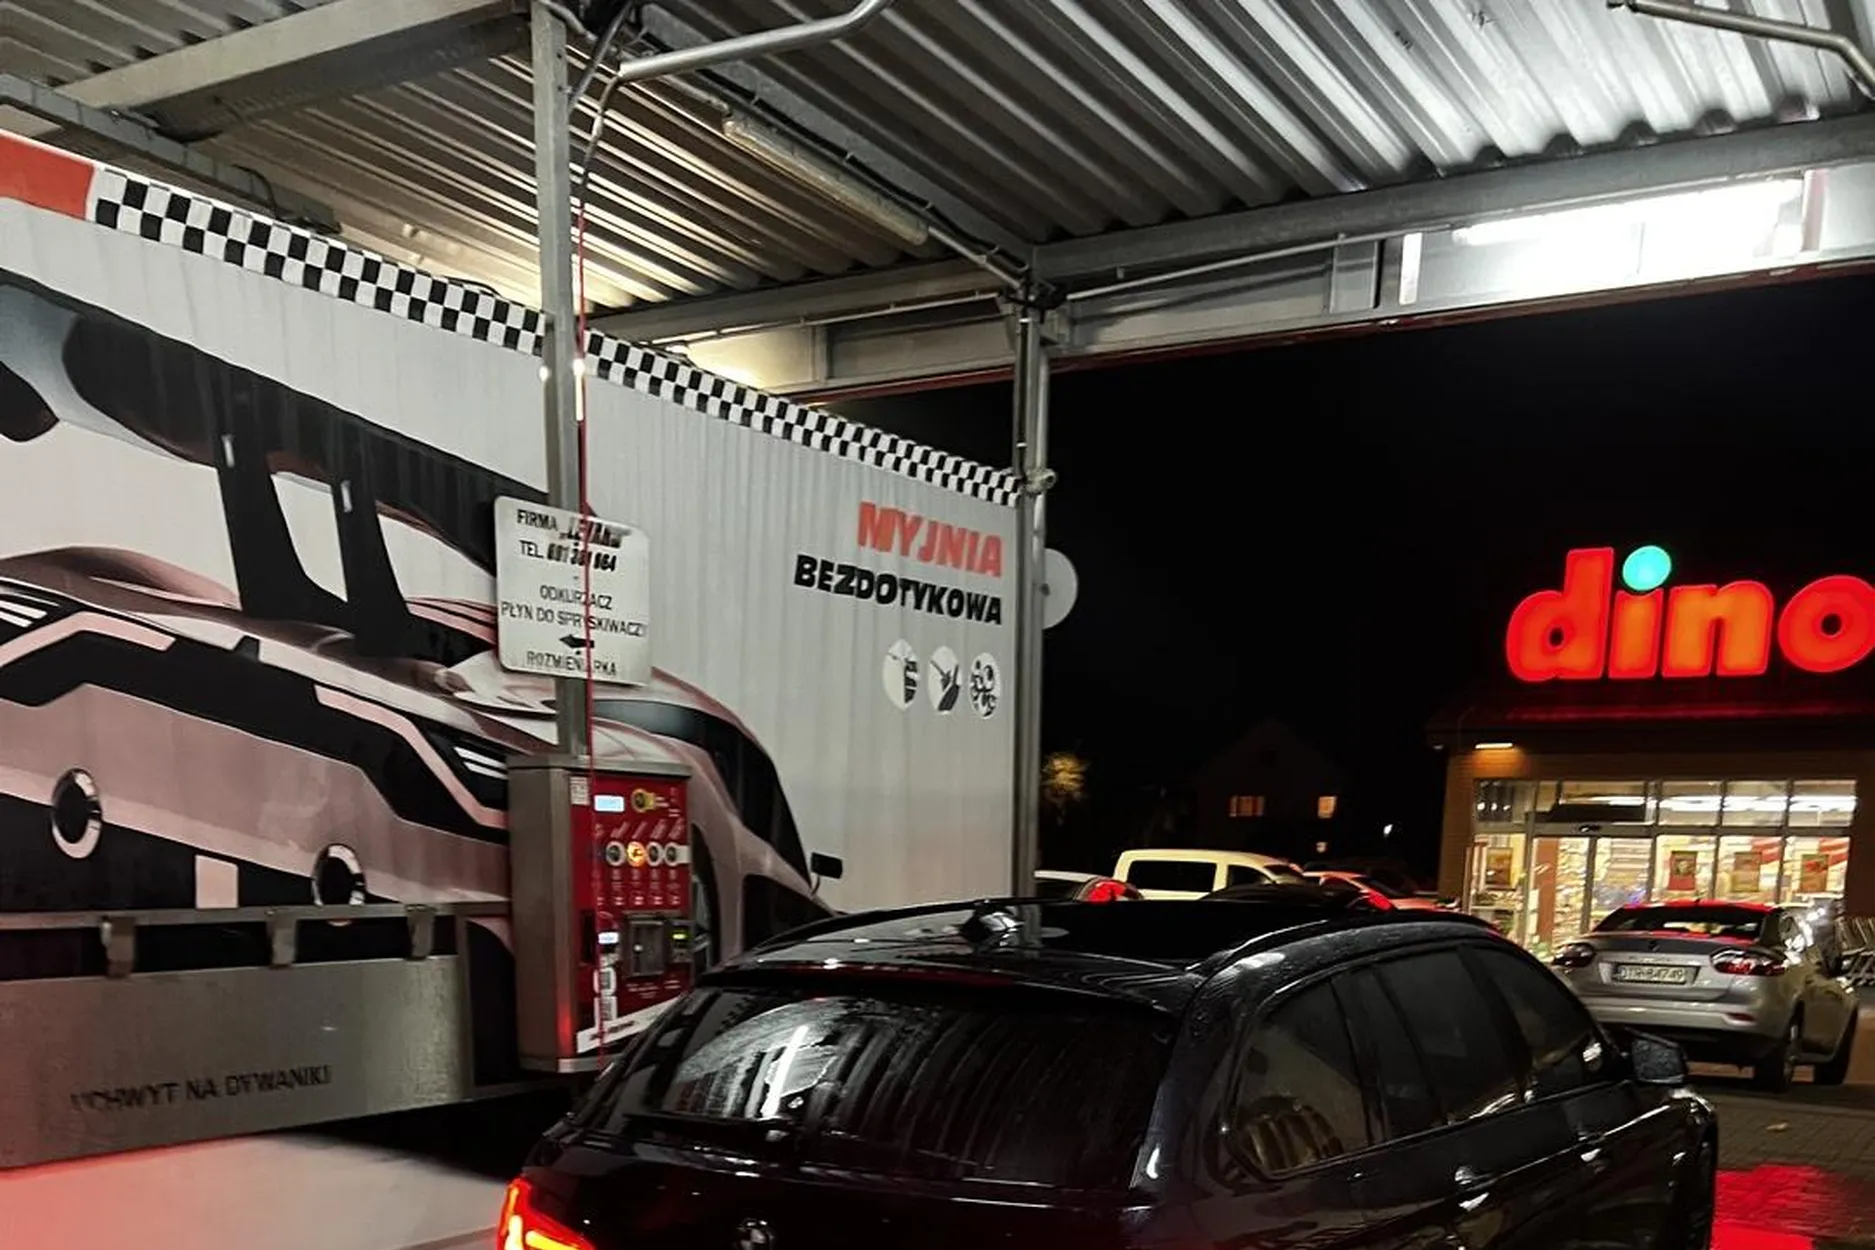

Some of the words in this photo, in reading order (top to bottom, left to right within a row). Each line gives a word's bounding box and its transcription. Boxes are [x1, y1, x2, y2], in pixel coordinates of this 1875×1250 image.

[517, 509, 558, 531] FIRMA
[857, 501, 1004, 578] MYJNIA
[794, 554, 1002, 625] BEZDOTYKOWA
[501, 601, 533, 619] PŁYN
[536, 607, 555, 623] DO
[1506, 545, 1875, 682] dino
[527, 651, 616, 676] ROZMIENRKA
[186, 1077, 218, 1099] NA
